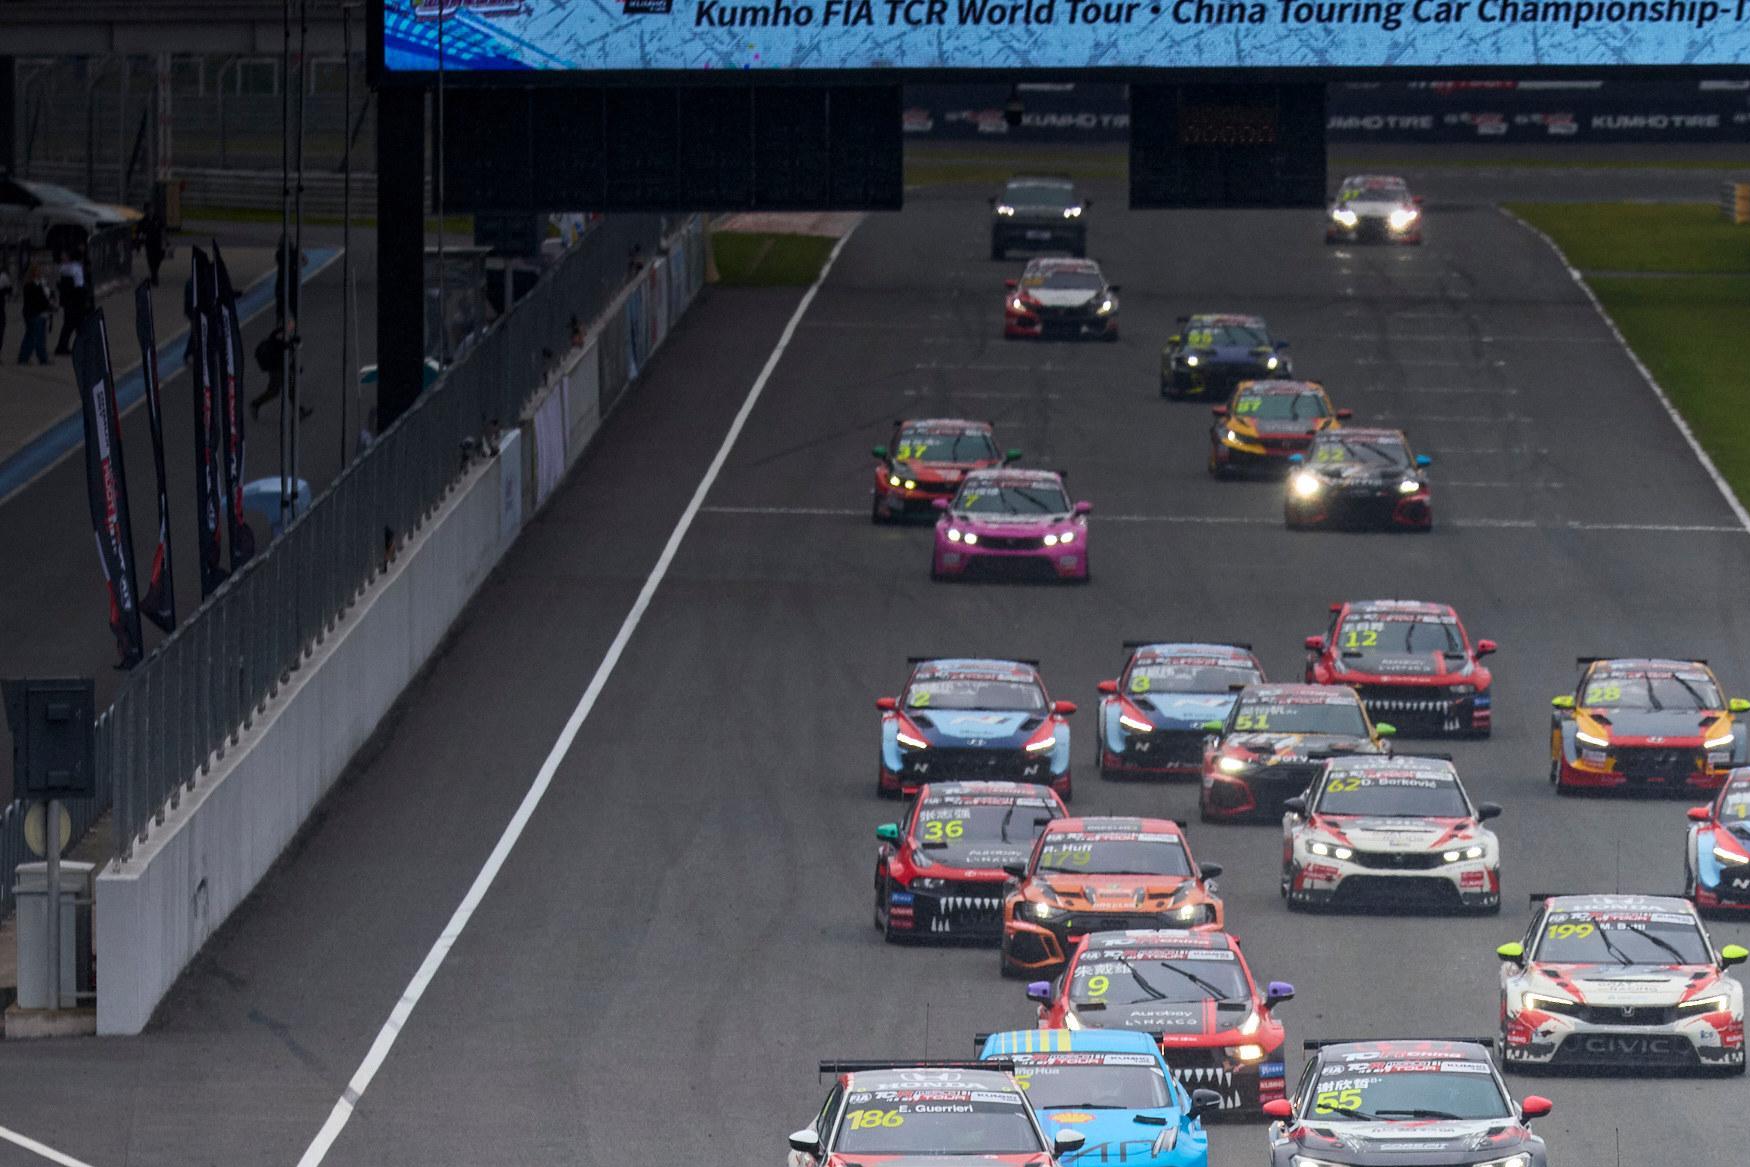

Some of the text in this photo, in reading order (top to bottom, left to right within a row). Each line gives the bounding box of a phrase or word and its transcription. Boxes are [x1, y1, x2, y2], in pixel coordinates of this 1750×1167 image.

[695, 0, 813, 27] Kumho
[822, 0, 875, 26] FIA
[886, 0, 946, 26] TCR
[957, 0, 1053, 25] World
[1067, 0, 1141, 25] Tour
[1172, 0, 1266, 24] China
[1278, 0, 1404, 30] Touring
[1413, 0, 1471, 23] Car
[1345, 630, 1377, 648] 12
[1586, 686, 1621, 705] 28
[1235, 714, 1269, 731] 51
[1327, 778, 1360, 793] 62
[924, 820, 963, 840] 36
[1042, 852, 1091, 868] 179
[1547, 924, 1595, 940] 199
[1088, 975, 1109, 996] 9
[1585, 1039, 1670, 1053] CIVIC
[1315, 1089, 1362, 1114] 55
[847, 1109, 911, 1130] 186
